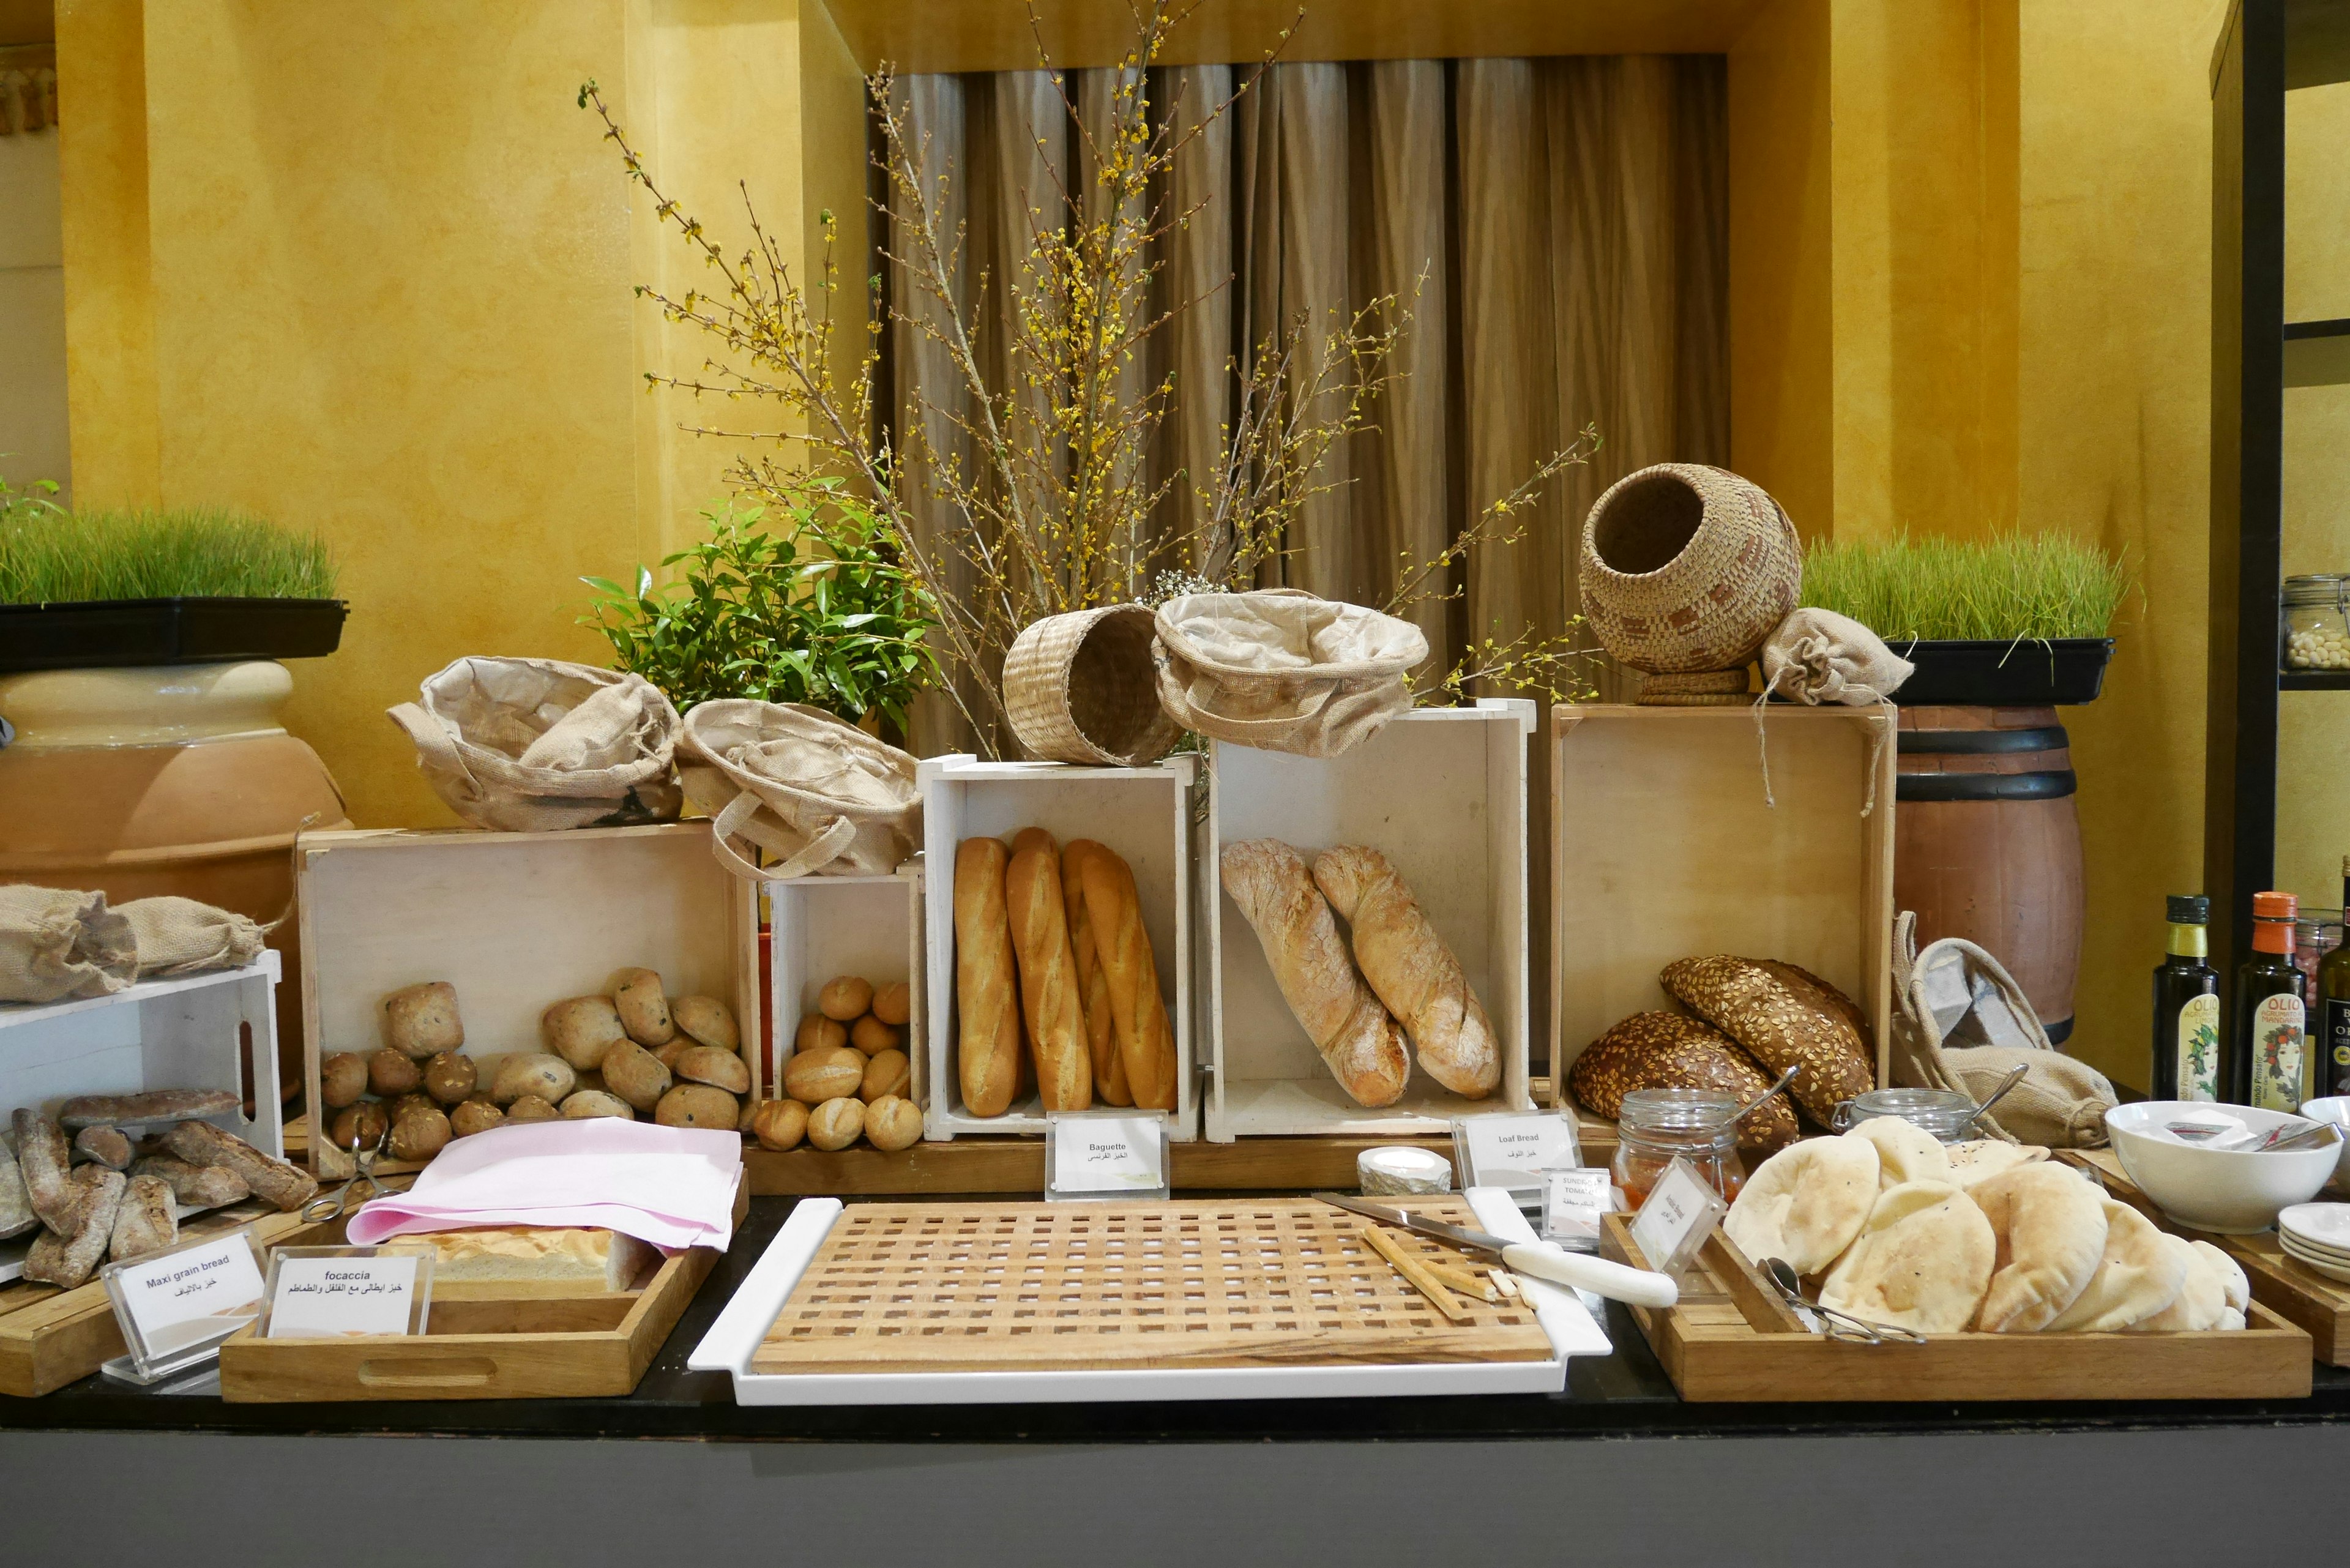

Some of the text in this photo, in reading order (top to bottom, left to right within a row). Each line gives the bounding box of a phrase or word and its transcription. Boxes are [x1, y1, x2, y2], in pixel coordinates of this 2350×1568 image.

[2194, 998, 2217, 1011] OLIO
[2268, 998, 2300, 1010] OLIO
[1089, 1143, 1126, 1152] Baguette
[146, 1255, 230, 1289] Maxi grain bread
[325, 1271, 370, 1280] focaccia
[205, 1278, 217, 1289] خبز
[288, 1283, 323, 1295] والطماطم
[387, 1283, 403, 1293] خبز
[348, 1286, 359, 1295] مع
